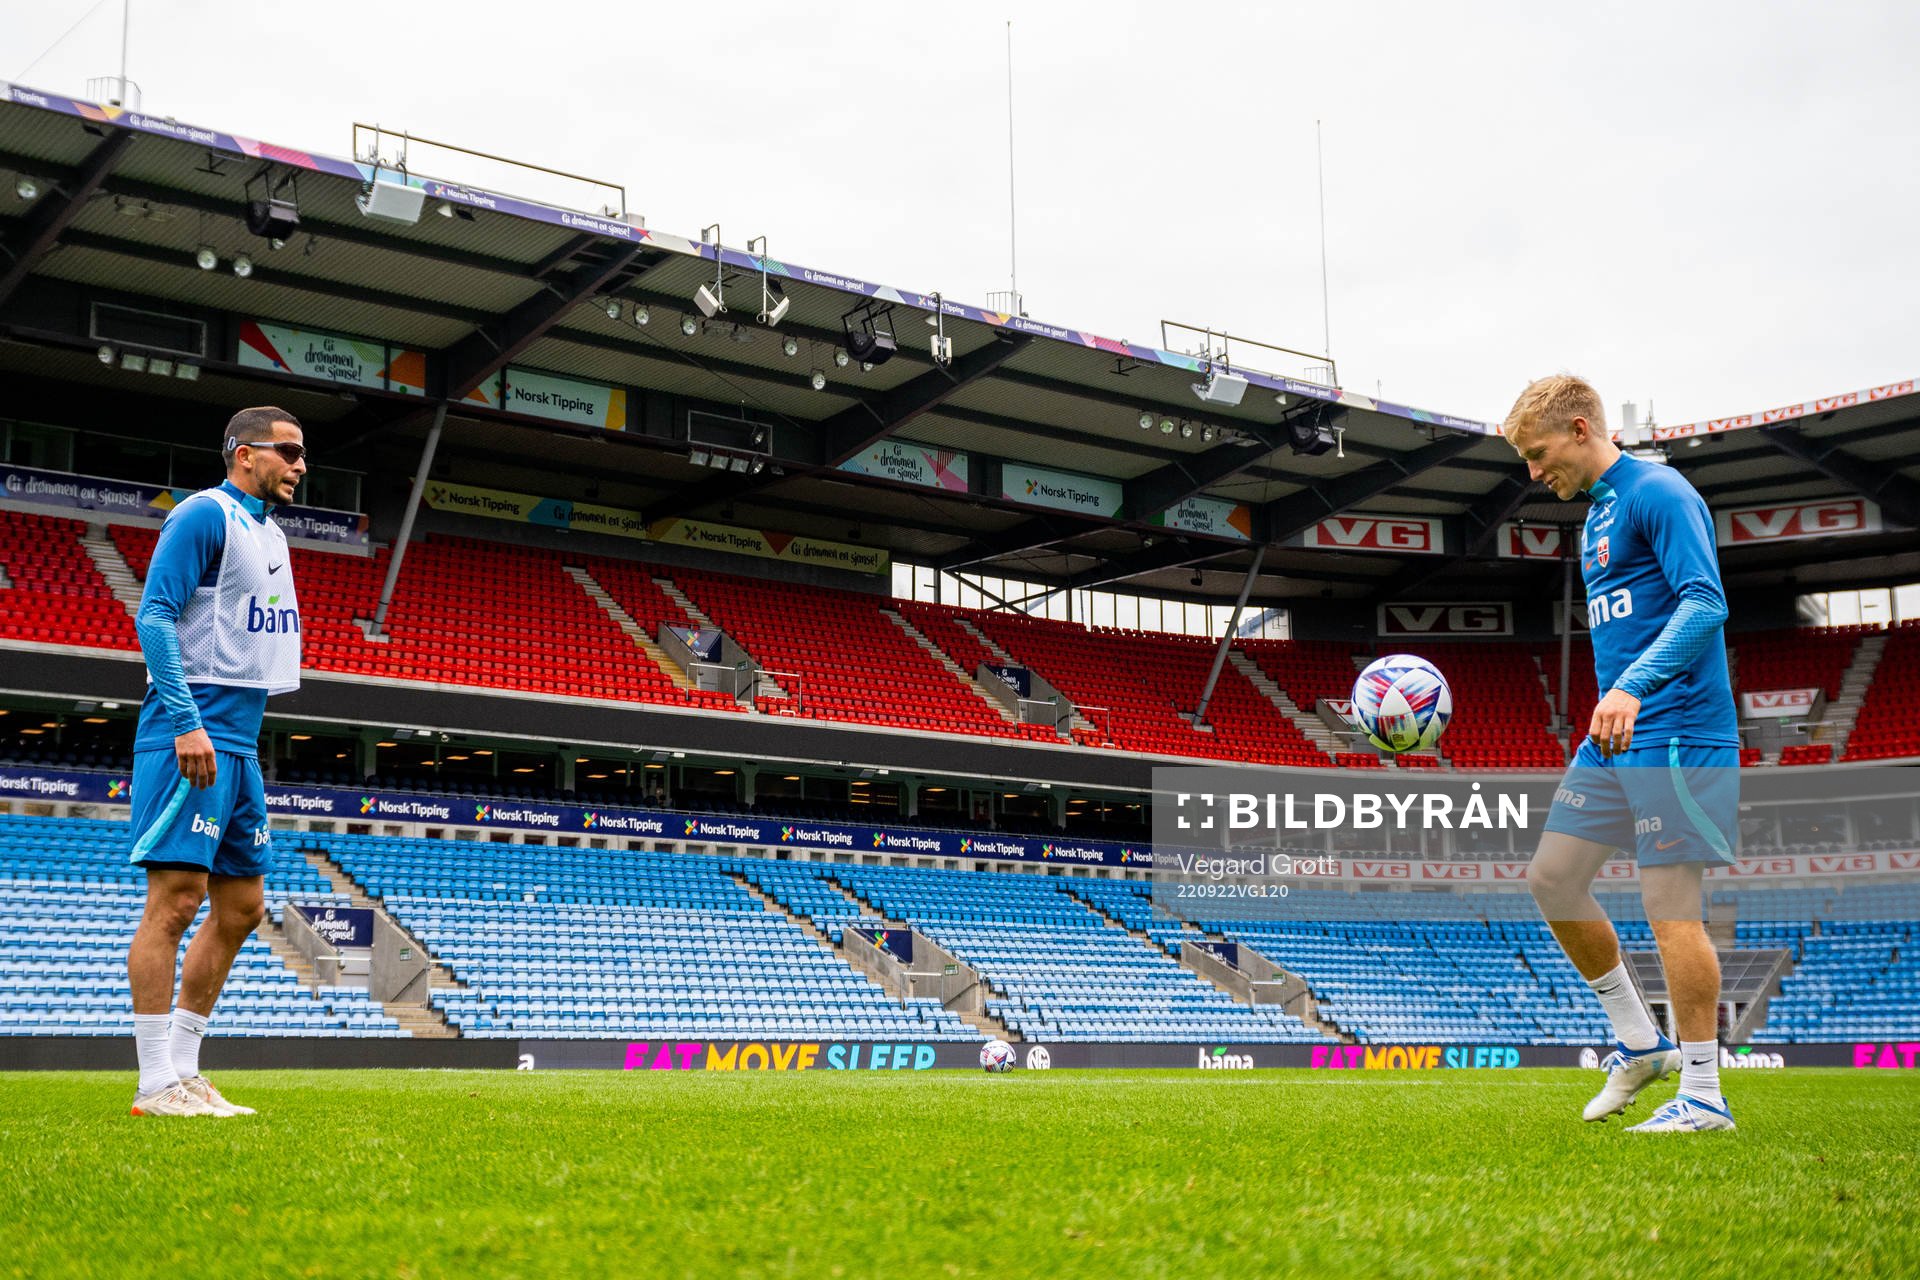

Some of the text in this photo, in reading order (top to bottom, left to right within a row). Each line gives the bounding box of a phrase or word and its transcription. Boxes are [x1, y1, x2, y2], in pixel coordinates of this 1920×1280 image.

[447, 188, 496, 209] Norsk Tipping
[323, 338, 334, 351] Gi
[305, 343, 354, 368] drømmen
[327, 364, 362, 382] sjanse!
[1871, 382, 1913, 399] VG
[515, 387, 594, 415] Norsk Tipping
[1817, 394, 1857, 411] VG
[1765, 405, 1802, 422] VG
[1710, 416, 1750, 430] VG
[1655, 426, 1694, 439] VG
[880, 448, 917, 469] drømmen
[893, 444, 902, 456] Gi
[897, 464, 923, 482] sjanse!
[6, 474, 21, 492] Gi
[25, 476, 78, 498] drømmen
[98, 488, 142, 508] sjanse!
[1041, 484, 1100, 507] Norsk Tipping
[450, 493, 519, 514] Norsk Tipping
[304, 517, 348, 537] Tipping
[1734, 502, 1859, 539] VG
[700, 530, 762, 551] Norsk Tipping
[1320, 519, 1425, 549] VG
[247, 595, 299, 633] bam
[1588, 588, 1632, 628] ma
[1389, 606, 1499, 632] VG
[1755, 691, 1809, 706] VG
[0, 776, 78, 796] orsk Tipping
[264, 793, 333, 812] orsk Tipping
[1553, 787, 1586, 808] ma
[379, 801, 449, 819] Norsk Tipping
[493, 808, 559, 826] Norsk Tipping
[191, 813, 220, 840] bam
[600, 816, 663, 833] Norsk Tipping
[700, 823, 760, 840] Norsk Tipping
[1635, 816, 1662, 836] ma
[796, 829, 852, 845] Norsk Tipping
[887, 835, 941, 852] Norsk Tipping
[973, 841, 1025, 857] Norsk Tipping
[1055, 847, 1104, 862] Norsk Tipping
[1133, 852, 1179, 867] Norsk Tipping
[1730, 859, 1793, 875] VG
[1812, 856, 1874, 871] VG
[1355, 863, 1409, 877] VG
[1425, 864, 1480, 878] VG
[1198, 1047, 1253, 1070] bama
